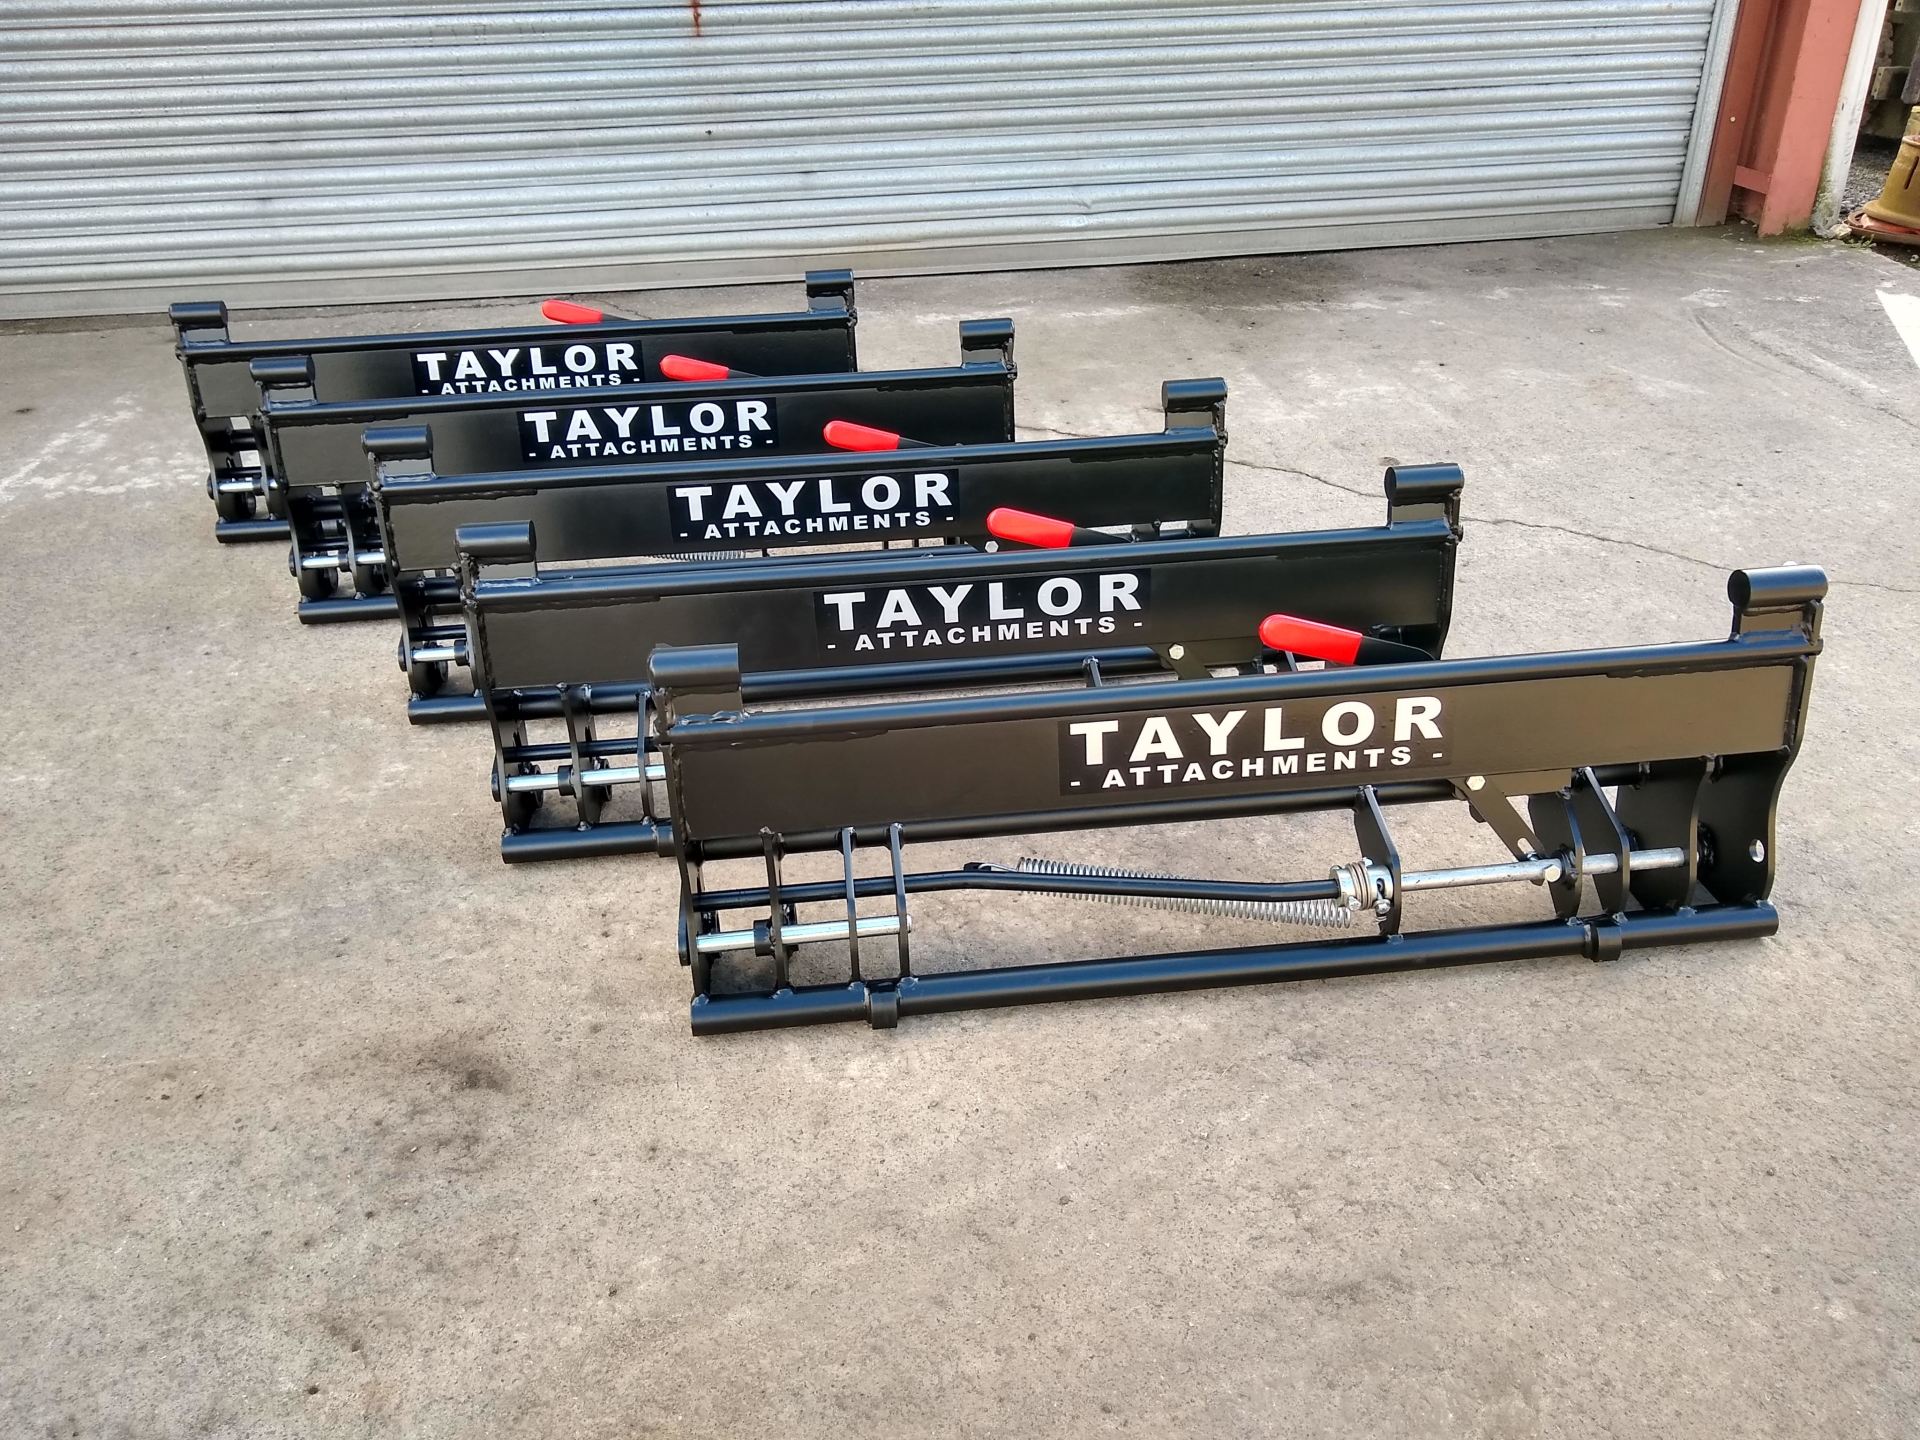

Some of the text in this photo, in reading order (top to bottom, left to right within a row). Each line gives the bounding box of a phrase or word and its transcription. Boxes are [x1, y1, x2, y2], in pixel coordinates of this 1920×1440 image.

[416, 343, 638, 381] TAYLOR
[441, 374, 622, 395] ATTACHMENTS
[523, 400, 772, 443] TAYLOR
[550, 434, 753, 459] ATTACHMENTS
[675, 473, 953, 522] TAYLOR
[704, 511, 931, 540] ATTACHMENTS
[823, 573, 1142, 632] TAYLOR
[854, 616, 1116, 651] ATTACHMENTS
[1069, 696, 1444, 766] TAYLOR
[1101, 746, 1412, 789] ATTACHMENTS
